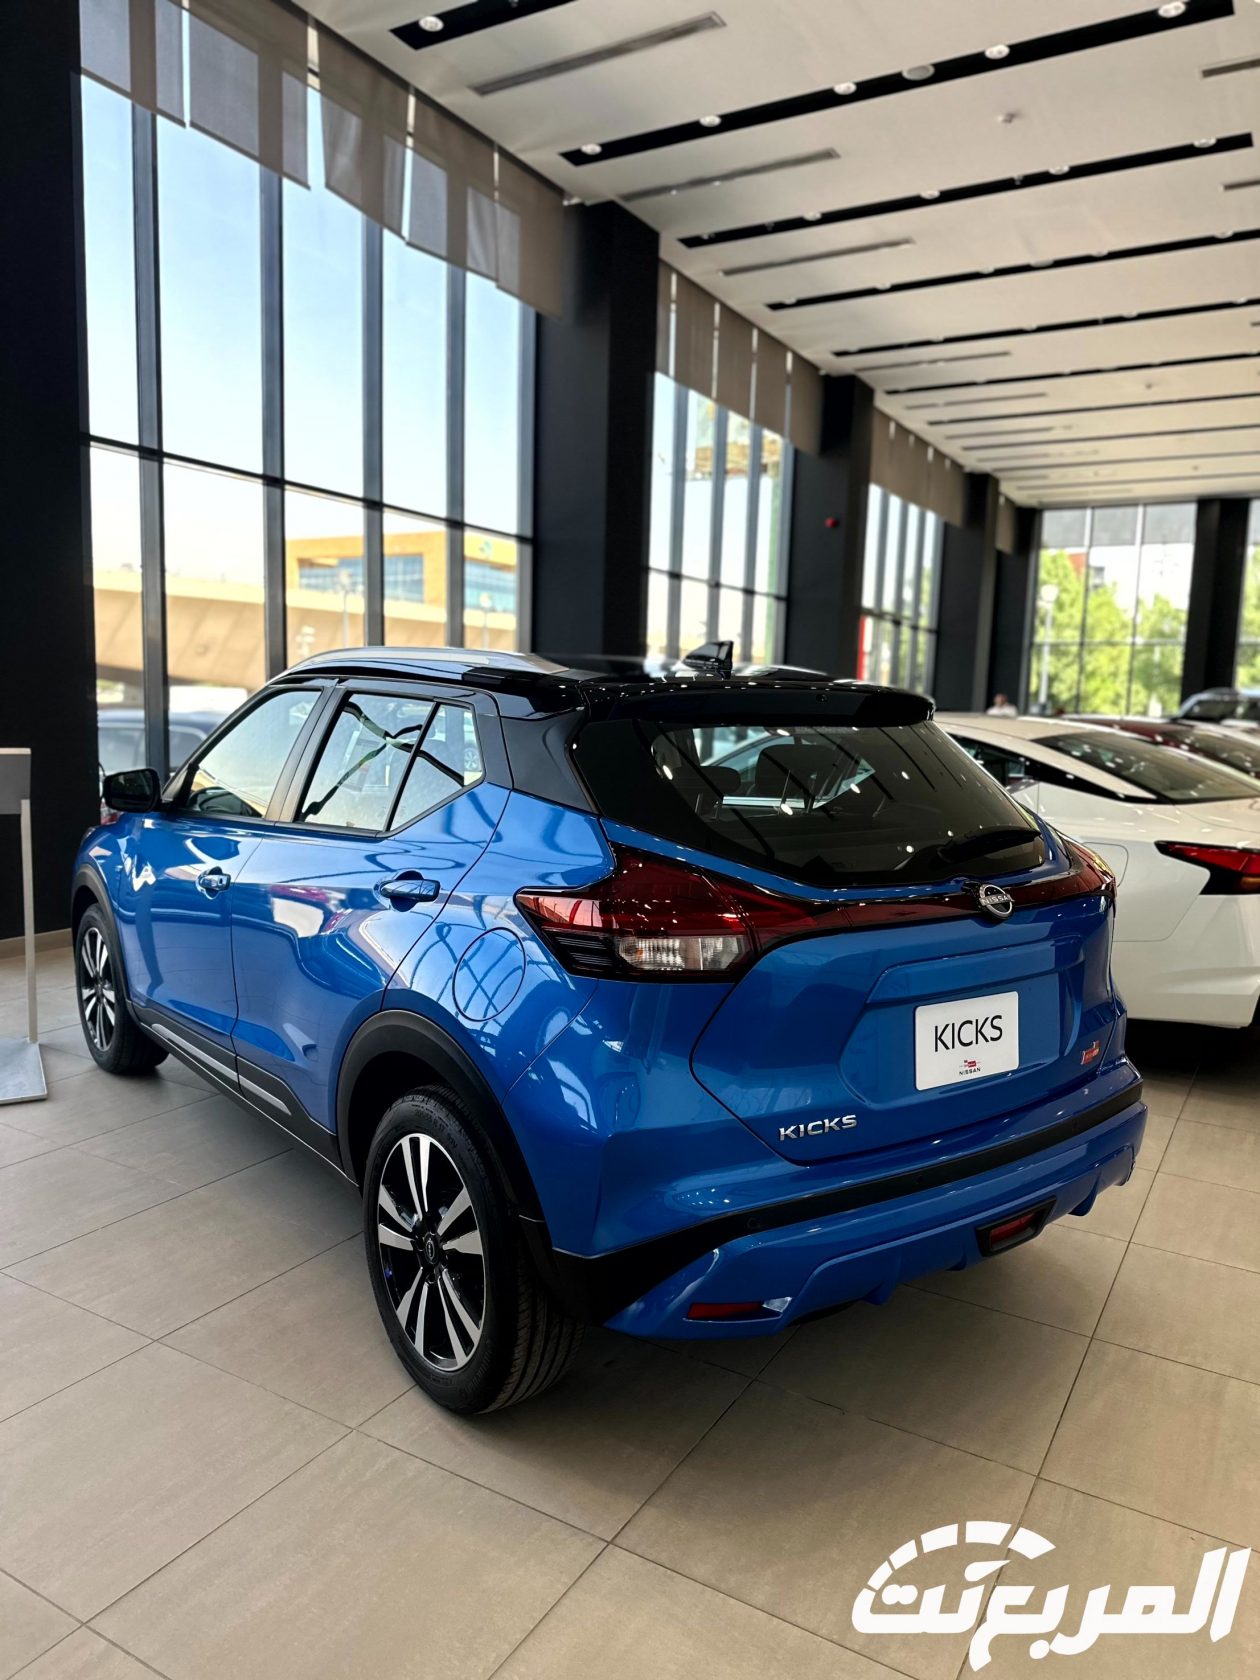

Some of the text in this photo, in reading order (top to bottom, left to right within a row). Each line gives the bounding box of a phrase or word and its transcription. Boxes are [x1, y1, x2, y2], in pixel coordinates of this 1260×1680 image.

[934, 1014, 1003, 1053] KICKS
[959, 1067, 981, 1076] NISSAN
[779, 1114, 858, 1141] KICKS
